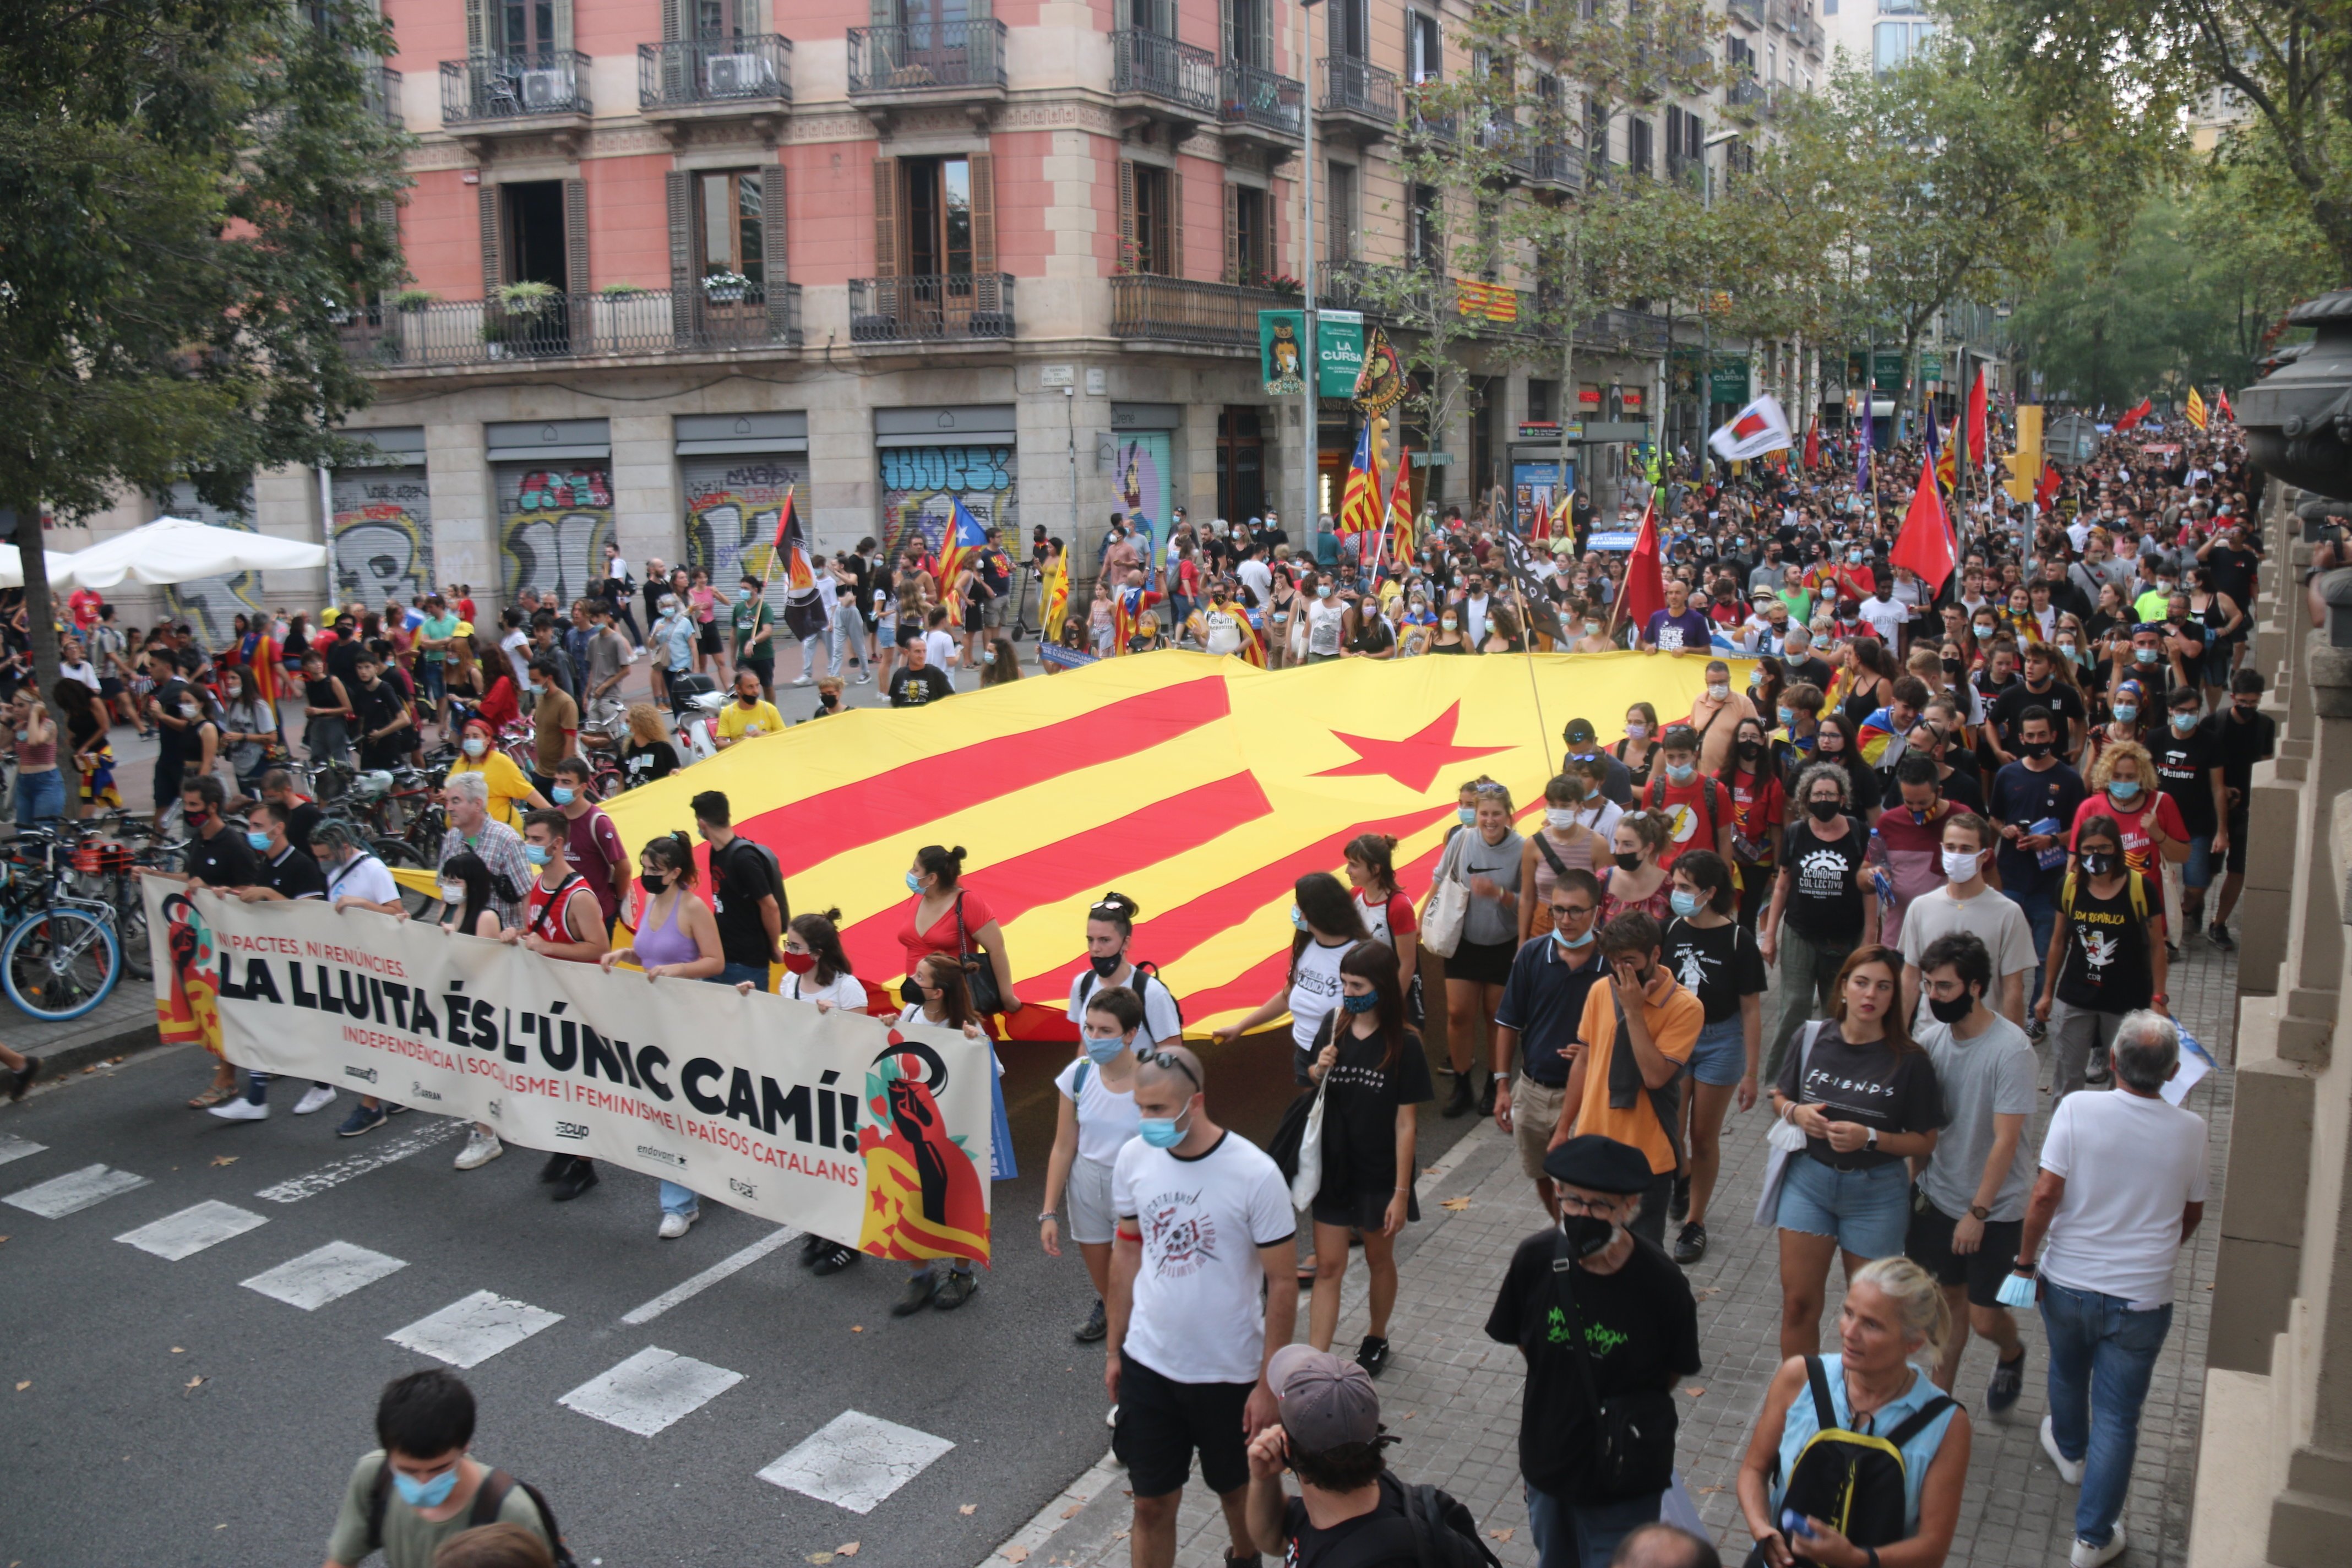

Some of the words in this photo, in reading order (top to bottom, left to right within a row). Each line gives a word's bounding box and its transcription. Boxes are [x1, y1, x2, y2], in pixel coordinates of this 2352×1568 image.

[1321, 351, 1363, 363] CURSA
[1337, 341, 1352, 351] LA
[216, 931, 231, 949] NI
[232, 935, 303, 958] PACTES,
[307, 941, 322, 958] NI
[325, 945, 409, 979] RENÚNCIES.
[220, 951, 285, 1004] LA
[288, 960, 440, 1039] LLUITA
[443, 980, 499, 1052] ÉS
[681, 1057, 859, 1154] CAMÍ!
[342, 1025, 456, 1071] INDEPENDÈNCIA
[575, 1084, 676, 1130] FEMINISME
[687, 1121, 749, 1156] PAÏSOS
[753, 1142, 859, 1187] CATALANS
[421, 1089, 442, 1101] ARRAN
